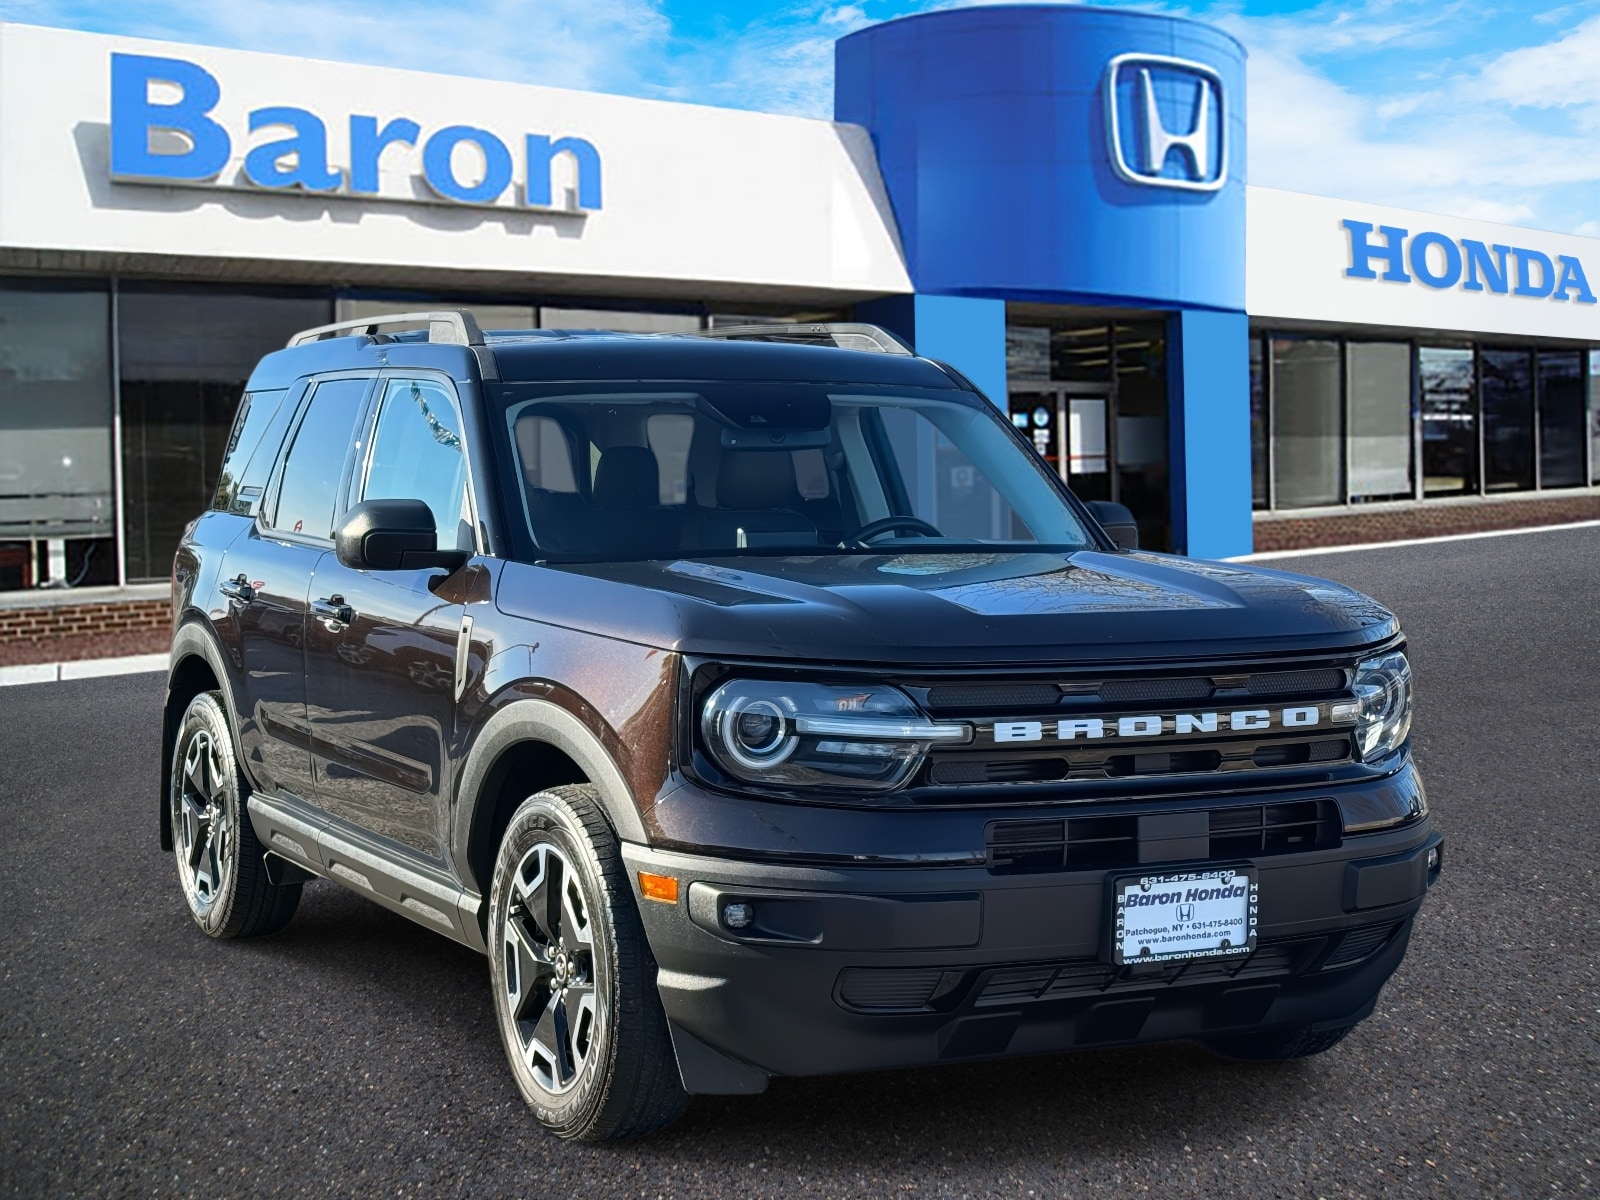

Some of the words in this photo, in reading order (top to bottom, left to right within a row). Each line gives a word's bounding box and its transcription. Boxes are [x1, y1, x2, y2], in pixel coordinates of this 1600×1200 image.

[110, 52, 602, 210] Baron
[1342, 219, 1597, 304] HONDA
[993, 707, 1320, 742] BRONCO
[1140, 870, 1236, 884] 631-475-8400
[1125, 892, 1183, 908] Baron
[1185, 885, 1246, 902] Honda
[1249, 883, 1259, 937] HONDA
[1116, 894, 1125, 951] BARON
[1125, 926, 1170, 937] Patchogue,
[1172, 923, 1185, 932] NY
[1191, 917, 1243, 930] 631-475-8400
[1137, 930, 1232, 945] www.baronhonda.com
[1123, 946, 1250, 965] www.baronhonda.com
